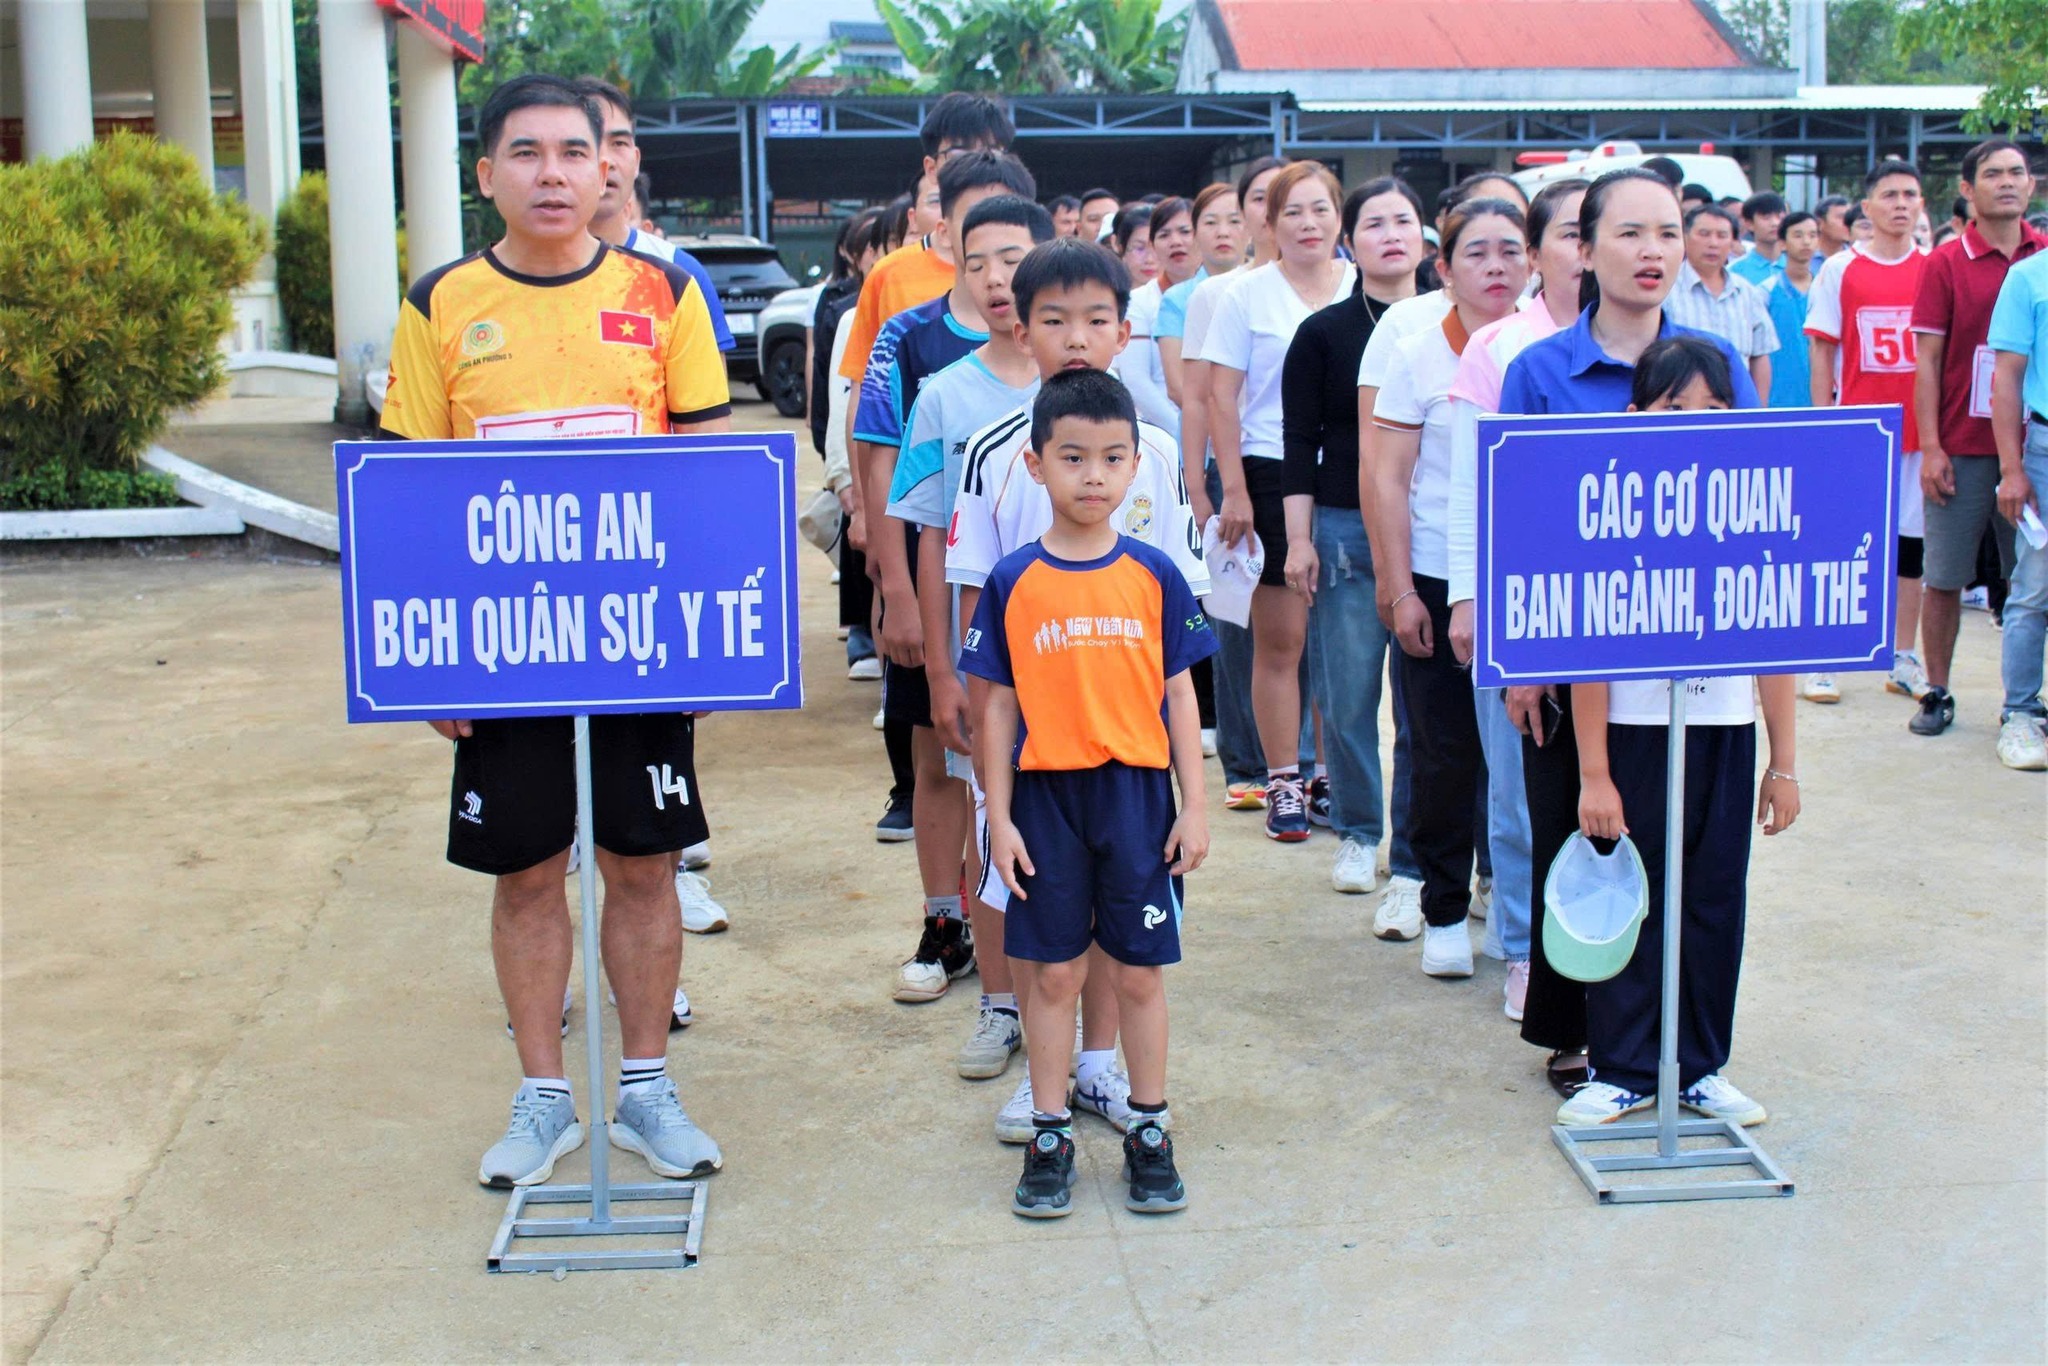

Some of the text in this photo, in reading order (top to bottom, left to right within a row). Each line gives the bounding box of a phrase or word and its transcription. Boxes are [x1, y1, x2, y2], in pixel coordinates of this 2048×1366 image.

[467, 480, 666, 568] CÔNG AN,
[1578, 458, 1801, 543] CÁC CƠ QUAN,
[373, 567, 766, 676] BCH QUÂN SỰ, Y TẾ
[1506, 532, 1872, 640] BAN NGÀNH, ĐOÀN THỂ
[1687, 683, 1706, 695] life
[646, 764, 689, 810] 14
